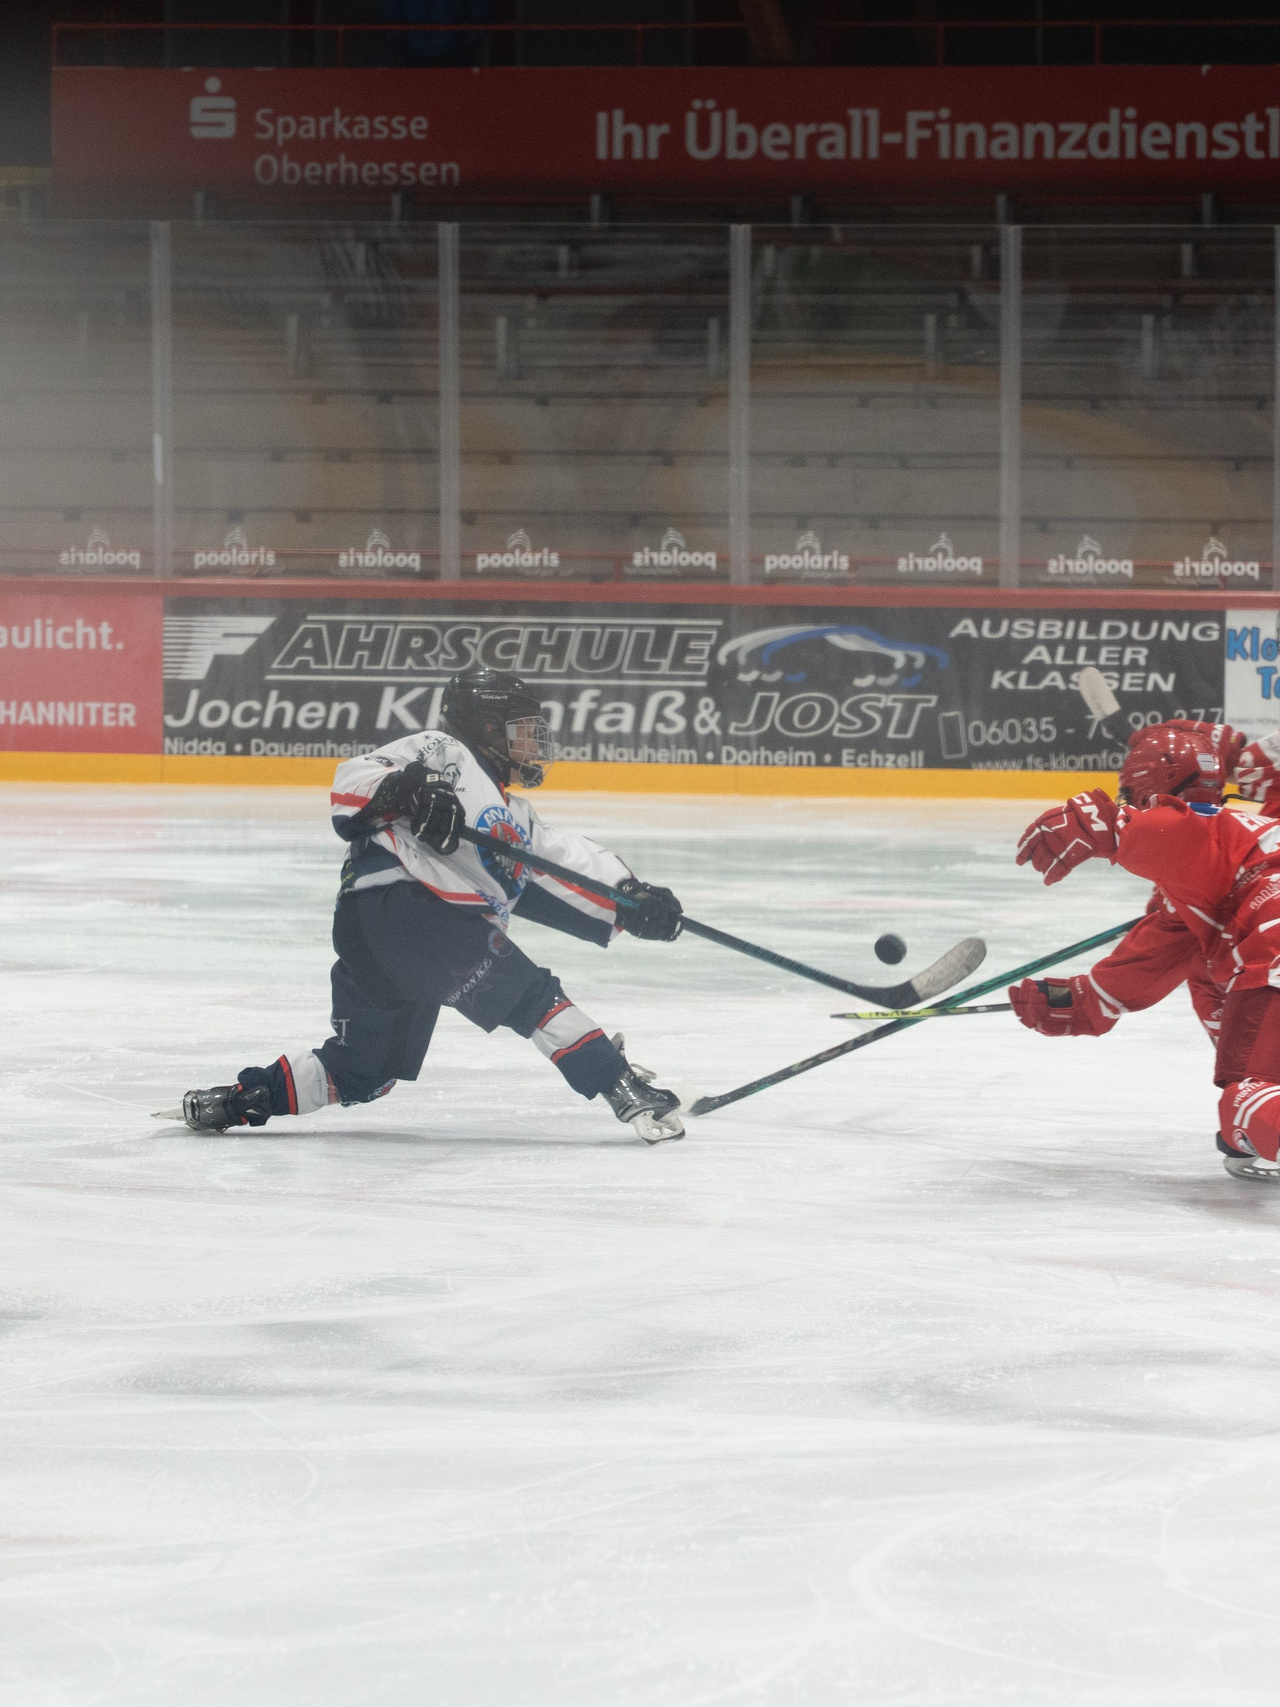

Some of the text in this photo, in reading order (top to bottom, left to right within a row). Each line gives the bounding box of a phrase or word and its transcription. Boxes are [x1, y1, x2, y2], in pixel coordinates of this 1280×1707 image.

[254, 107, 429, 146] Sparkasse
[596, 109, 670, 160] Ihr
[254, 154, 461, 187] Oberhessen
[948, 617, 1220, 643] AUSBILDUNG
[1021, 646, 1150, 668] ALLER
[164, 689, 361, 733] Jochen
[728, 691, 938, 739] JOST
[967, 717, 1058, 747] 06035
[164, 737, 227, 756] Nidda
[598, 743, 699, 763] Nauheim
[721, 745, 816, 766] Dorheim
[841, 748, 925, 769] Echzell
